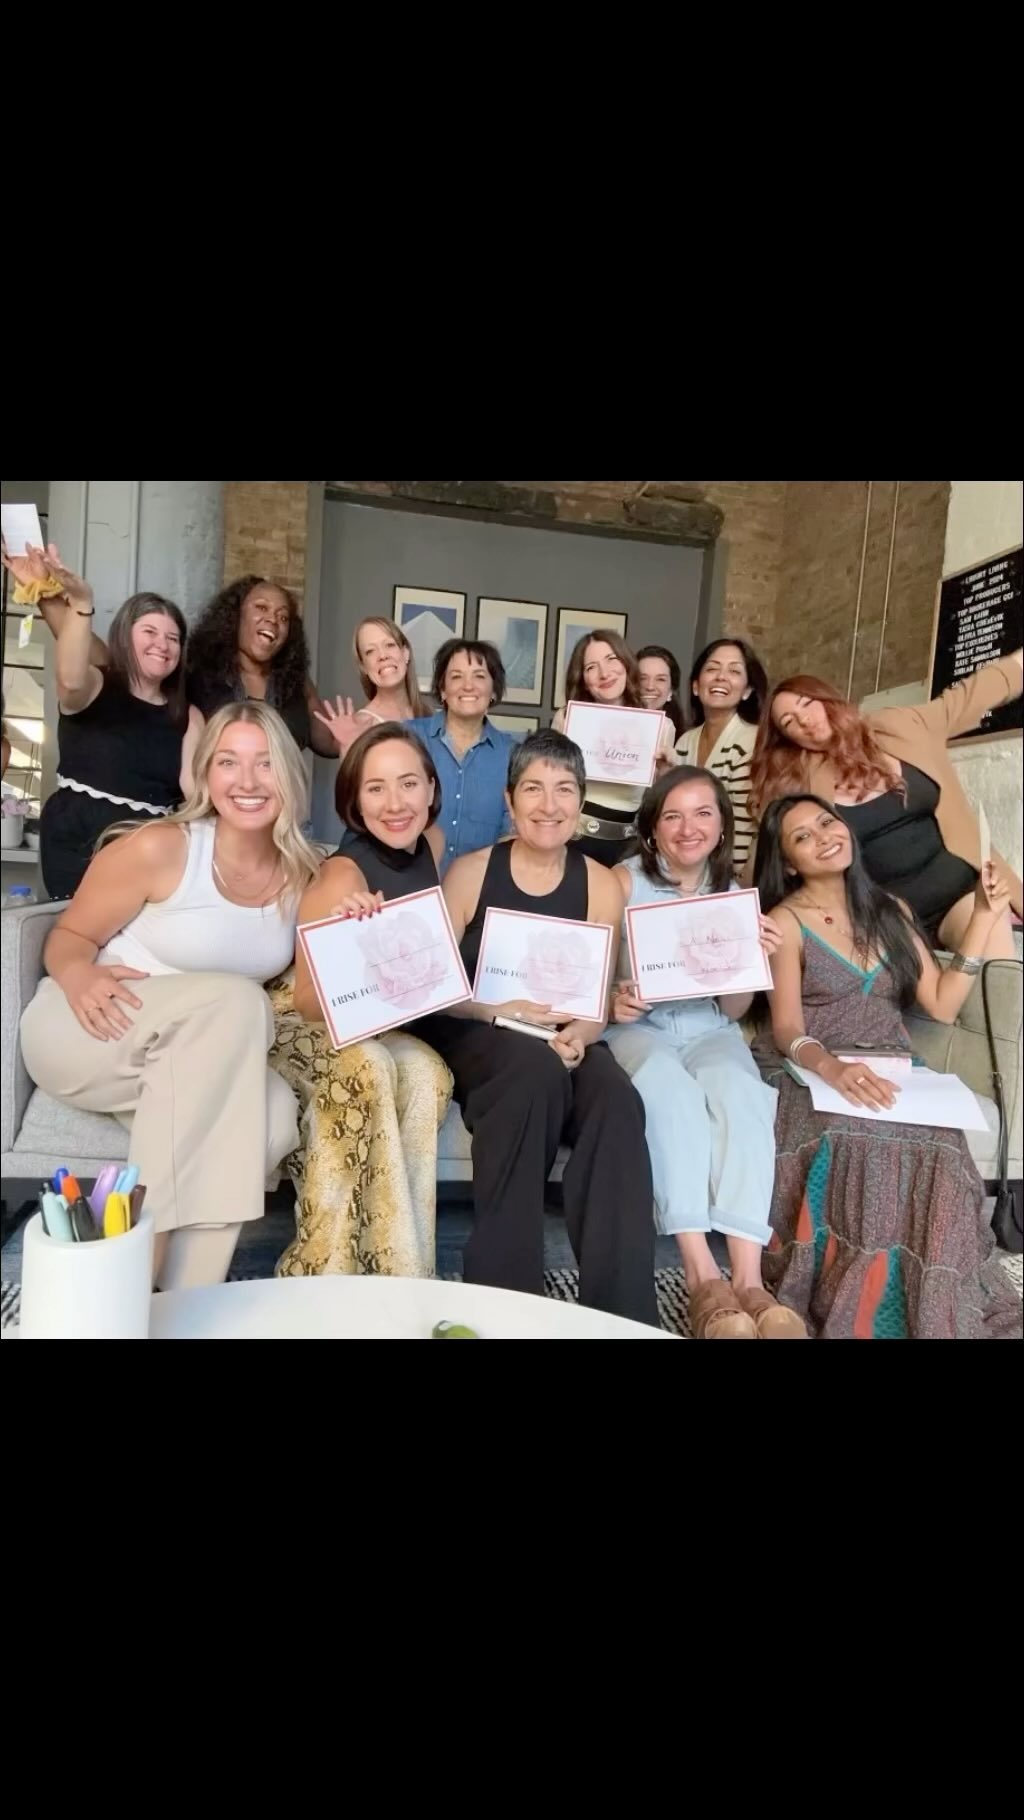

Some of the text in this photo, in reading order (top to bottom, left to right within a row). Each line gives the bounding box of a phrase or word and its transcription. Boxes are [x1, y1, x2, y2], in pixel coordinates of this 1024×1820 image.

[988, 561, 1008, 575] LIVING
[963, 582, 1010, 606] TOP PRODUCERS
[957, 608, 968, 618] TOP
[954, 643, 965, 651] TOP
[641, 960, 686, 972] I RISE FOR
[490, 967, 509, 976] RISE
[510, 970, 528, 979] FOR
[331, 983, 380, 1007] I RISE FOR
